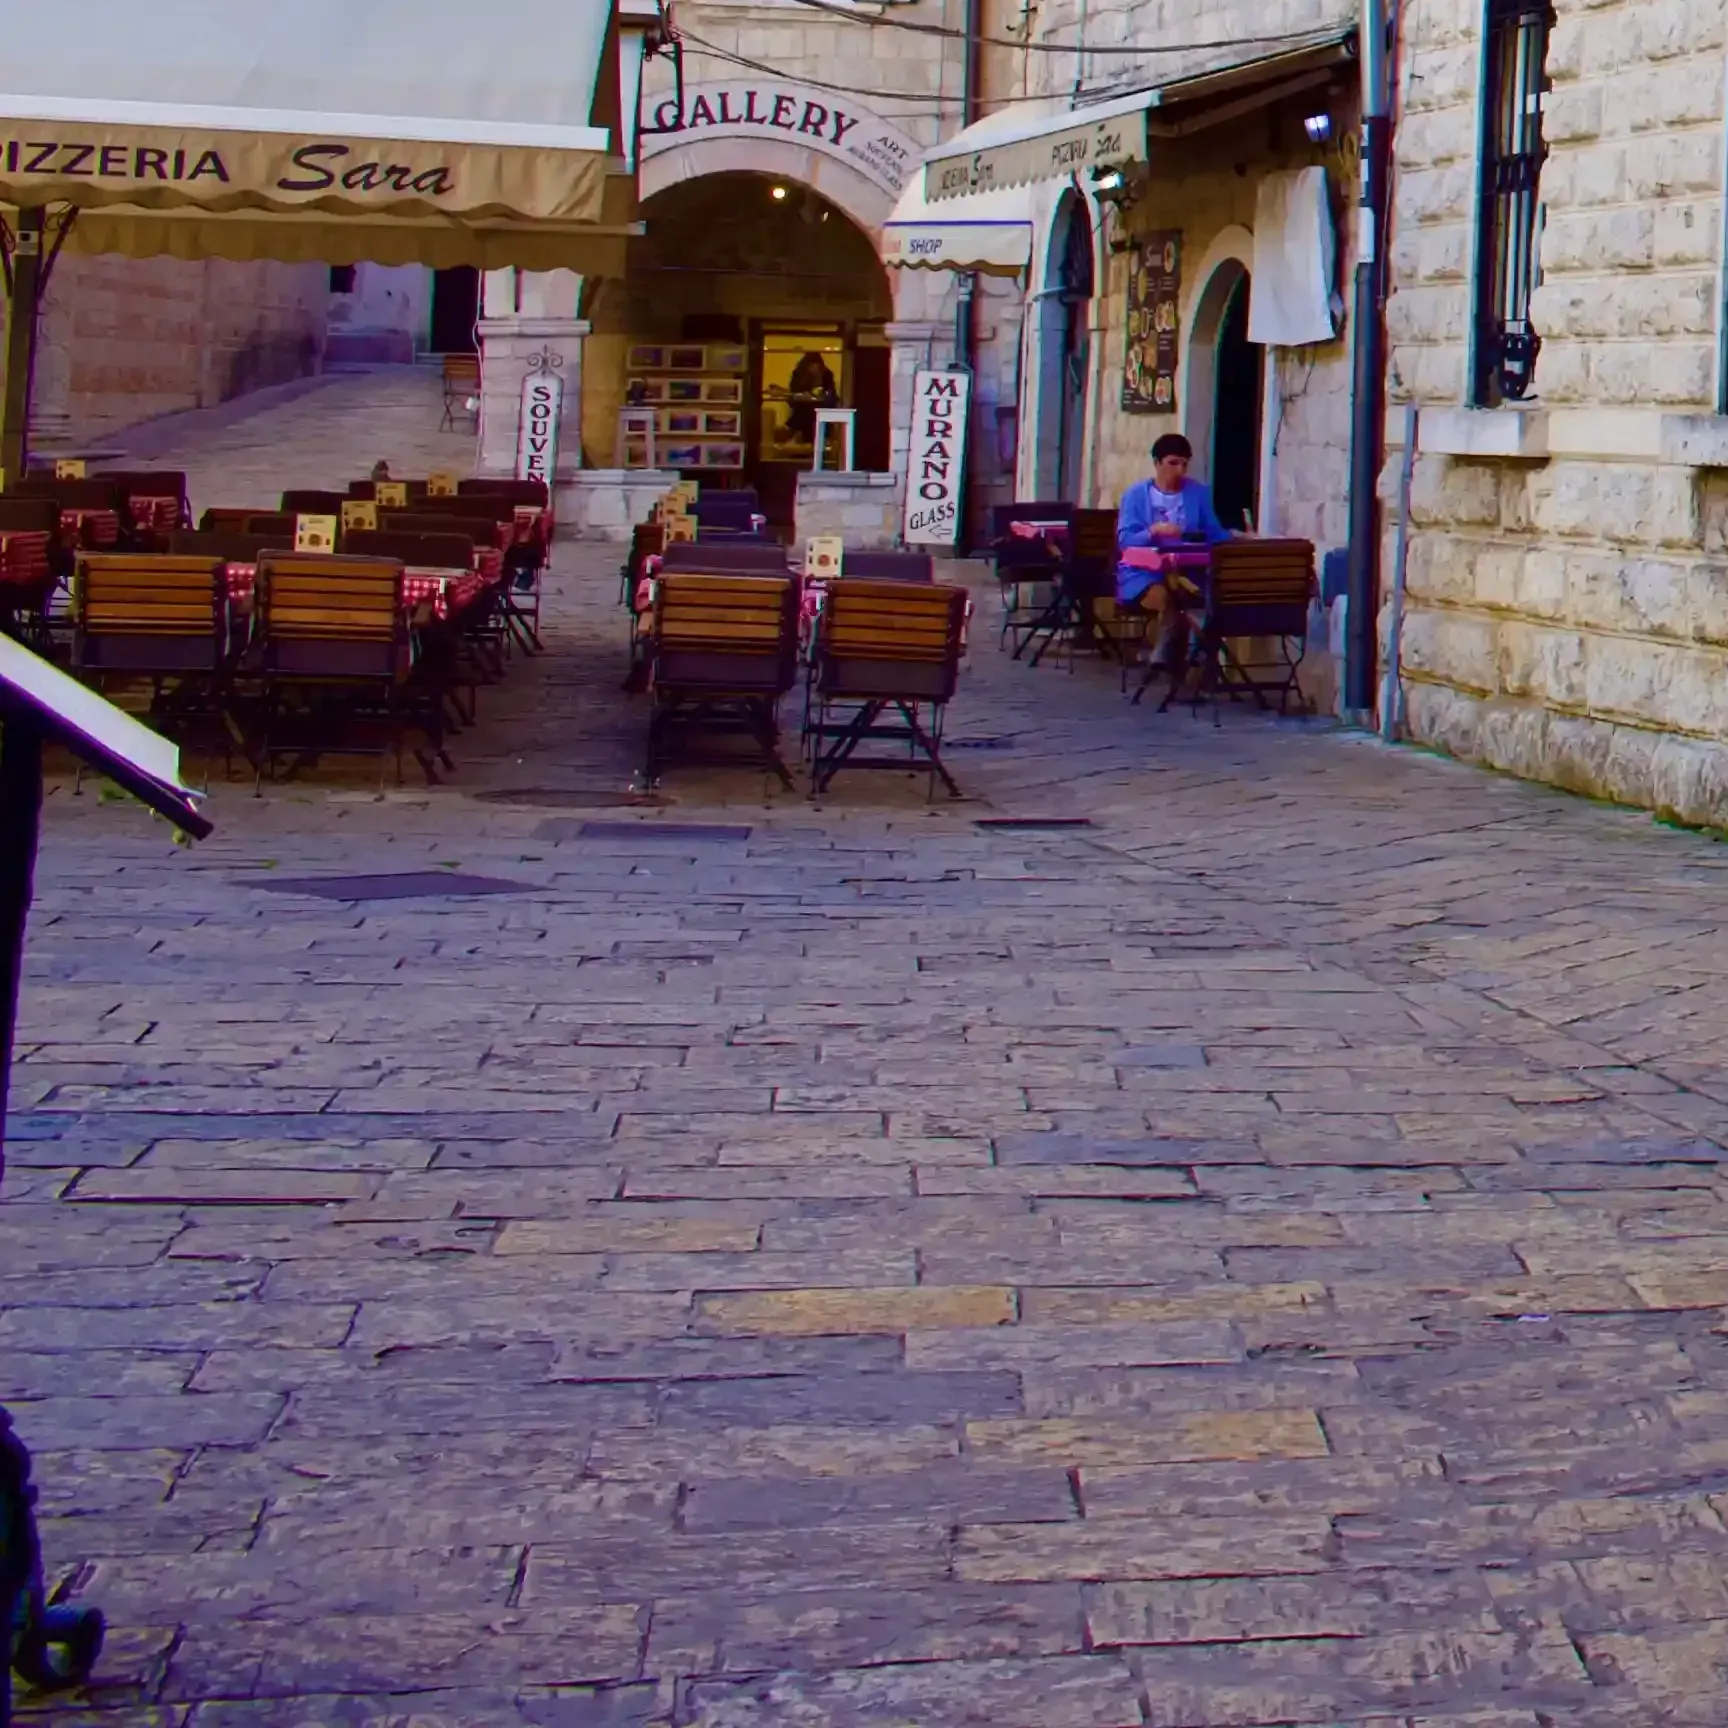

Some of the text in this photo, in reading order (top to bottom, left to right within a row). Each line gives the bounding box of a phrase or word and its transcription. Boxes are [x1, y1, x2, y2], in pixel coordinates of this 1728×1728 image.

[653, 90, 859, 147] GALLERY
[877, 136, 909, 160] ART
[276, 143, 456, 196] Sara
[909, 238, 943, 254] SHOP
[918, 377, 959, 501] MURANO
[909, 501, 956, 531] GLASS
